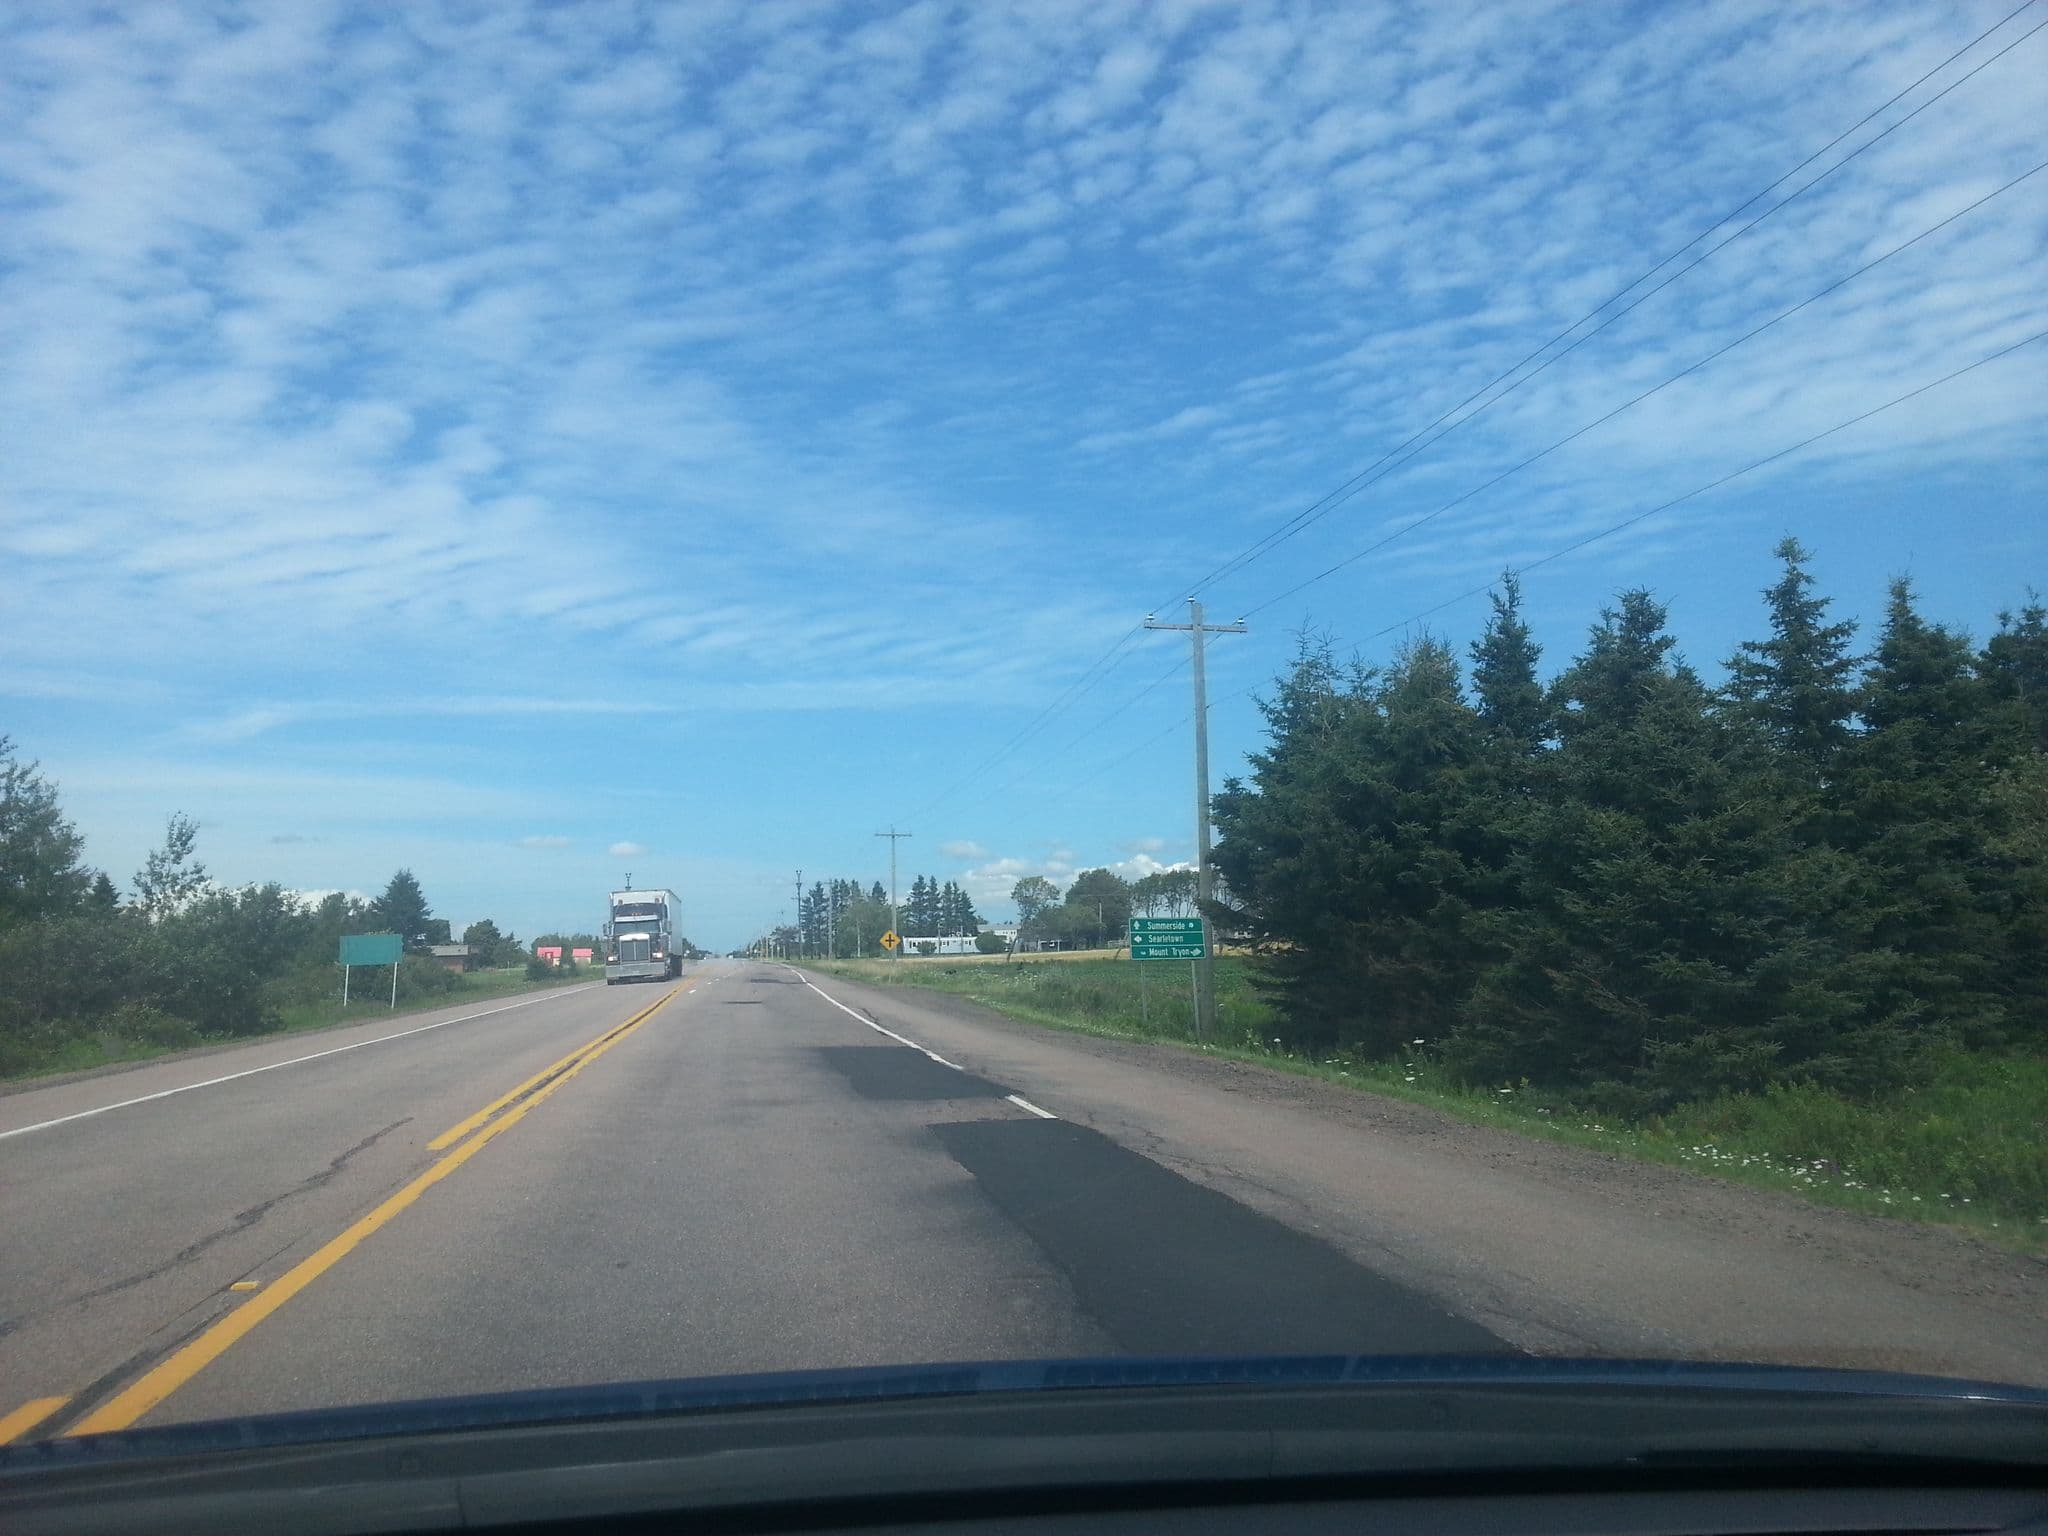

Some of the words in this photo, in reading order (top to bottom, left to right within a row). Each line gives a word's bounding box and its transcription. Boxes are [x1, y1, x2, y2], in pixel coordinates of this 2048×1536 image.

[1147, 921, 1186, 930] Summerside
[1149, 947, 1169, 957] Mount
[1172, 947, 1190, 958] Tryon
